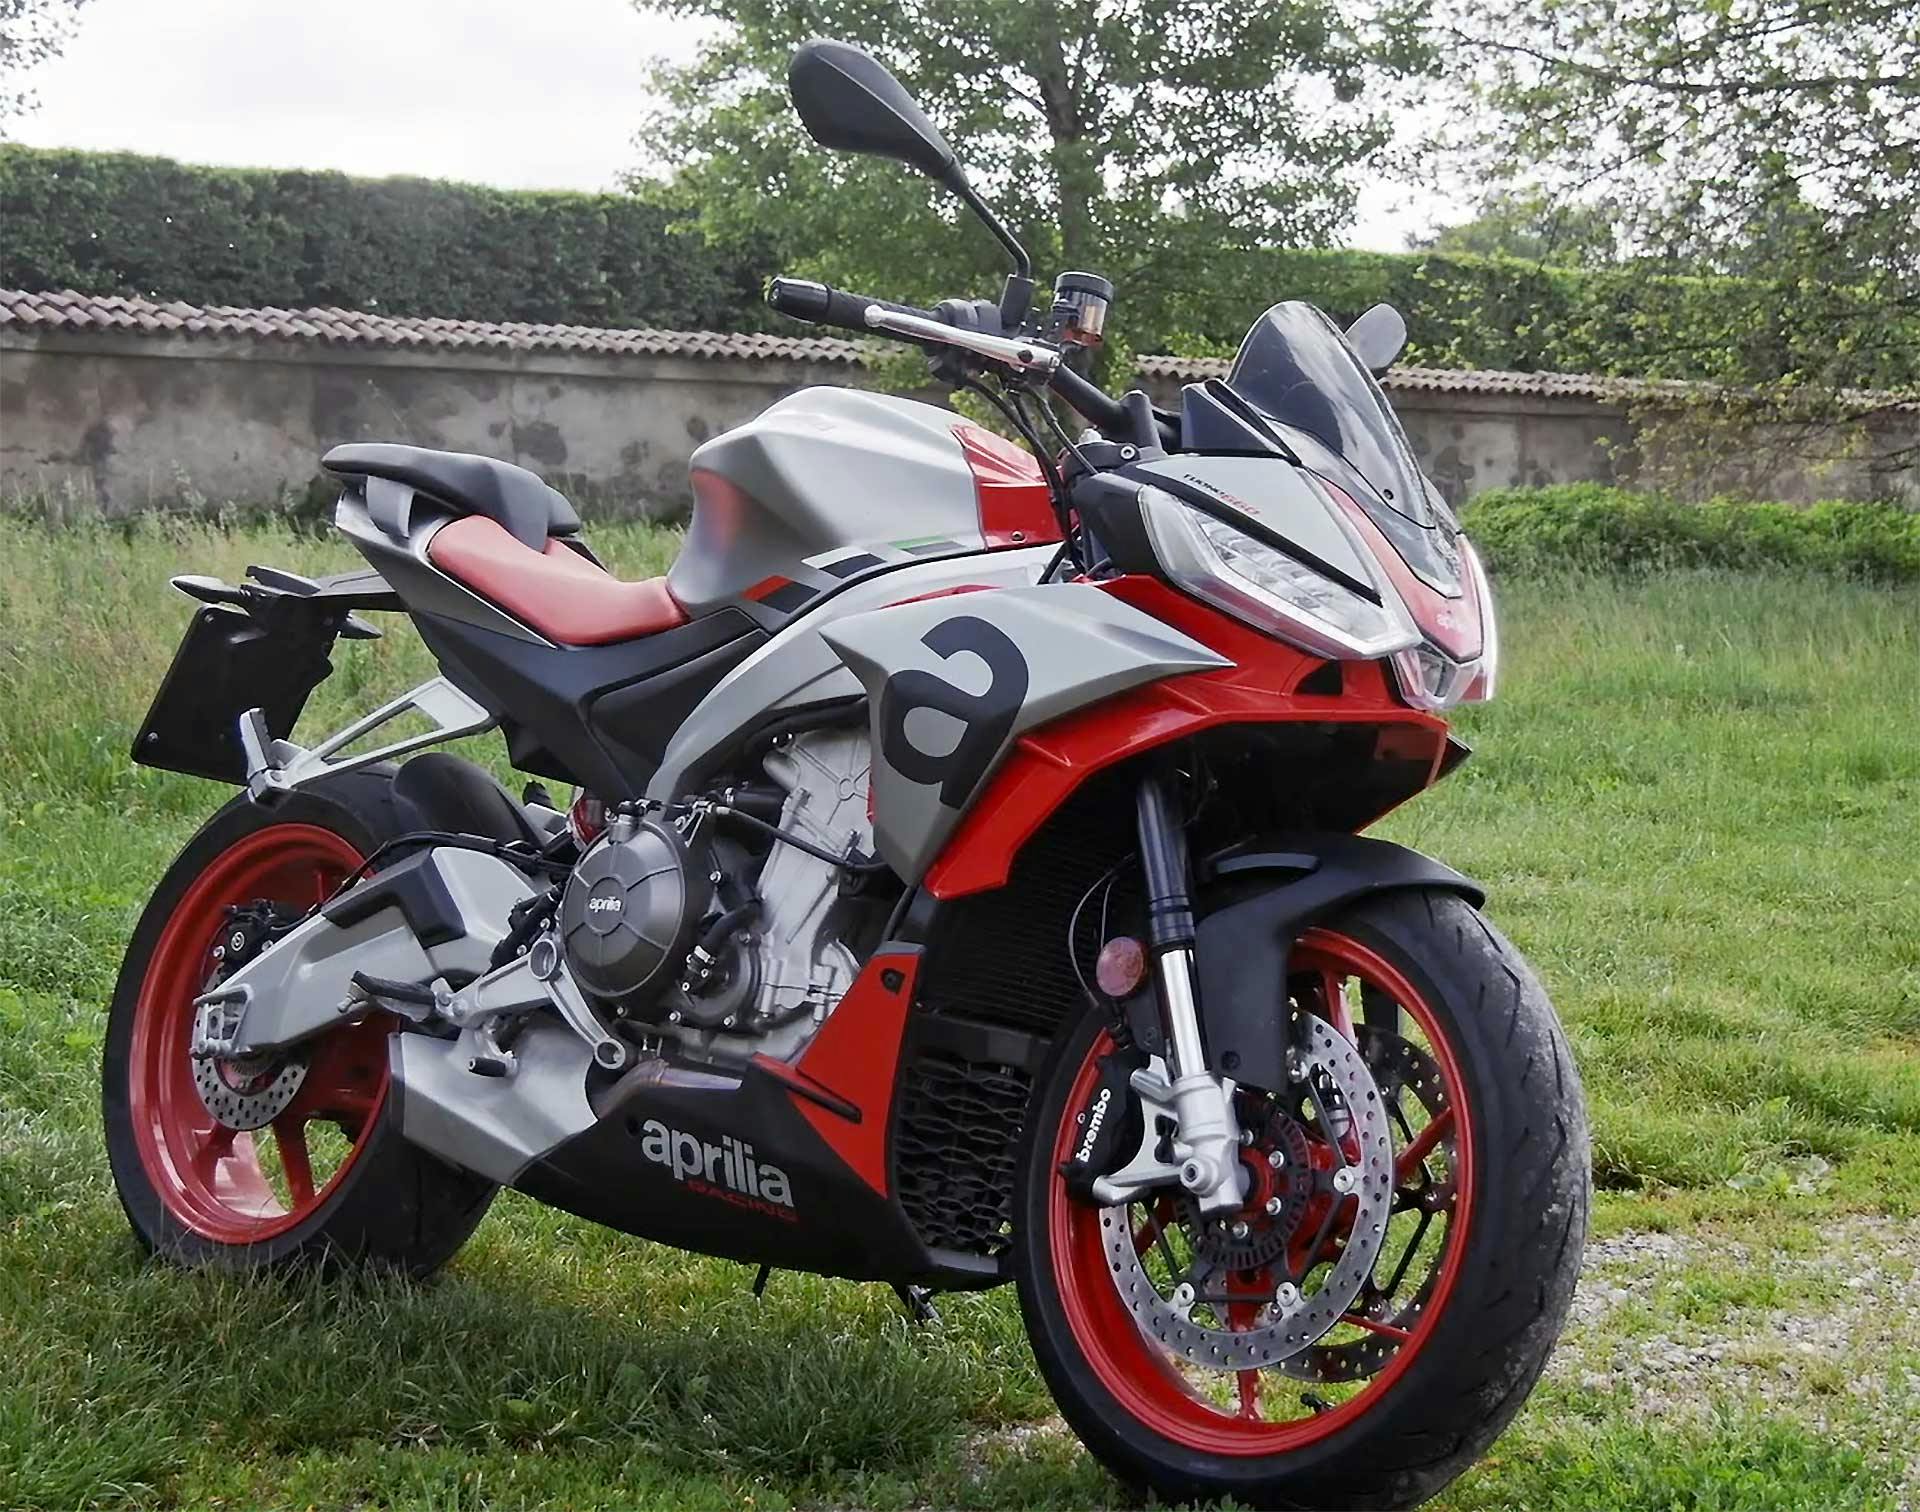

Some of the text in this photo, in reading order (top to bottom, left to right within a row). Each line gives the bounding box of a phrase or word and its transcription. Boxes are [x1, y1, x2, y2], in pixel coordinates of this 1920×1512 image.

[589, 896, 621, 912] aprilia
[1076, 1088, 1111, 1162] brembo
[641, 1119, 794, 1207] aprilia
